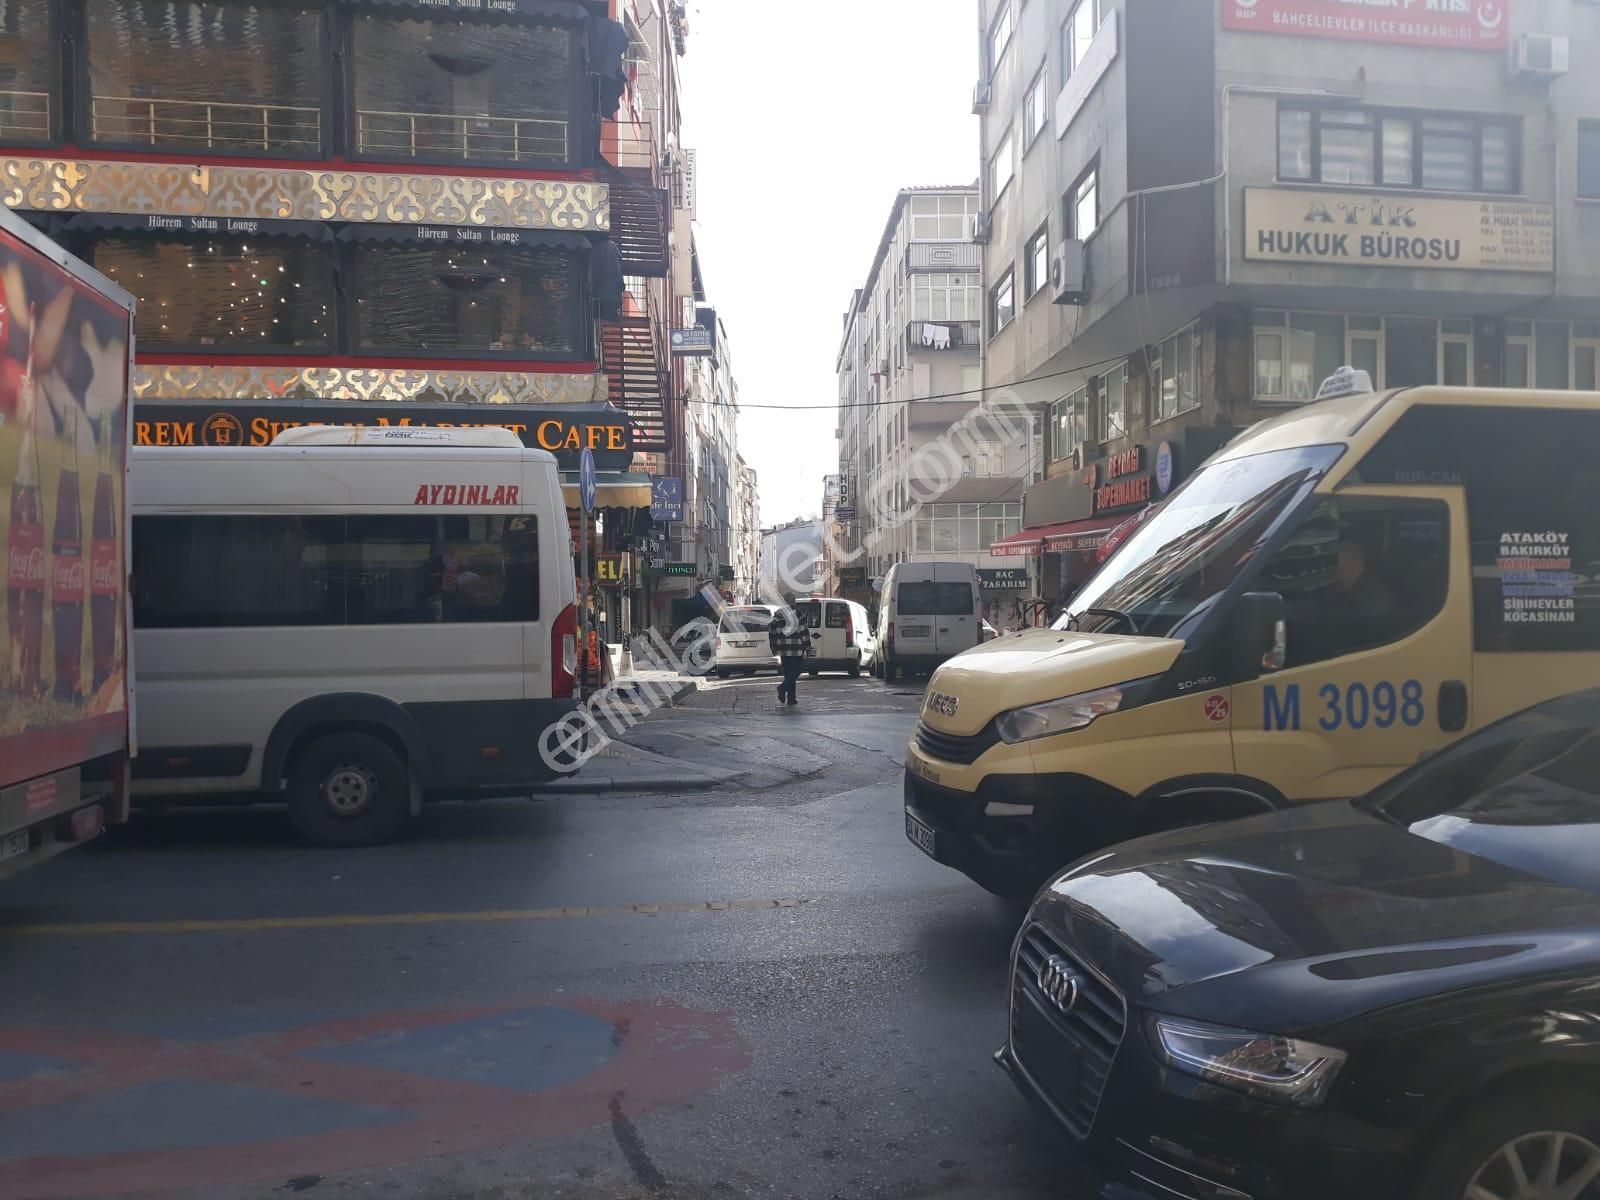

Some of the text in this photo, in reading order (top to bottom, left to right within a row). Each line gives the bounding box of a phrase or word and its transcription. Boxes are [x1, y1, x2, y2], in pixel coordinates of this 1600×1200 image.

[148, 215, 258, 232] Hürrem Sultan Lounge
[417, 226, 520, 244] Hürrem Sultan Lounge
[1257, 229, 1461, 261] HUKUK BÜROSU
[134, 422, 196, 446] REM
[536, 420, 627, 450] CAFE
[414, 484, 519, 505] AYDINLAR
[1500, 531, 1568, 543] ATAKÖY
[1500, 544, 1570, 556] BAKIRKÖY
[983, 580, 1026, 589] TASARIM
[1503, 609, 1575, 622] KOCASİNAN
[1262, 679, 1425, 732] M 3098
